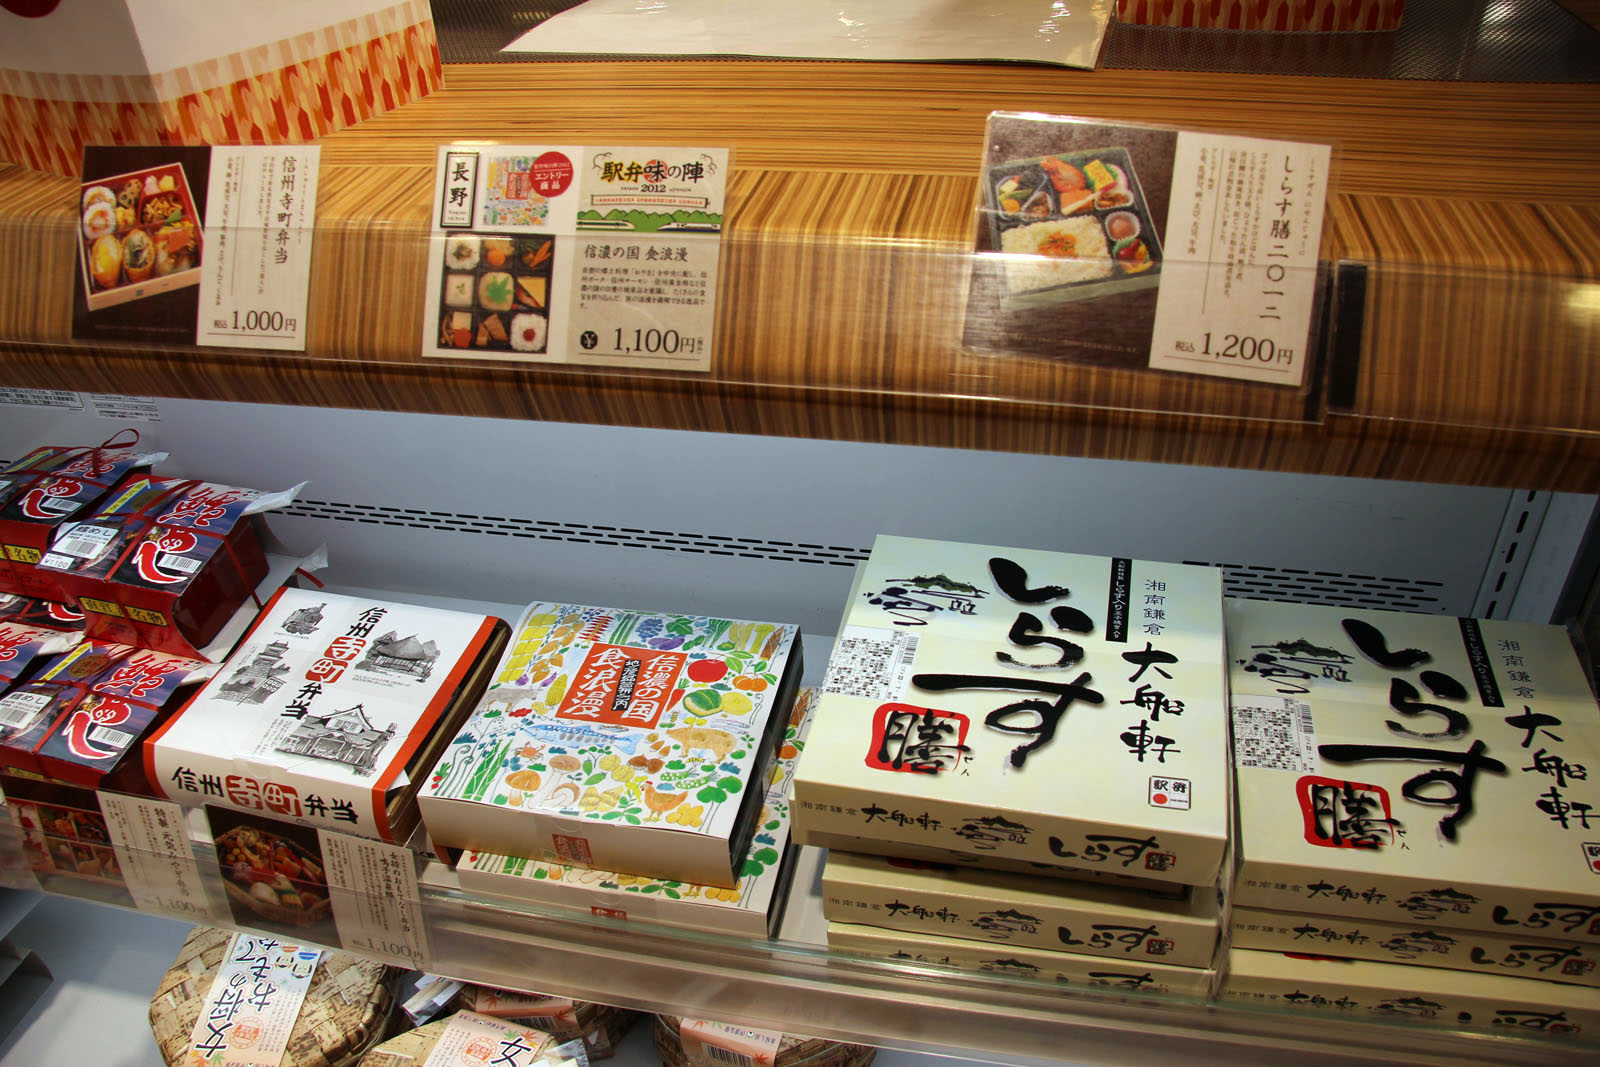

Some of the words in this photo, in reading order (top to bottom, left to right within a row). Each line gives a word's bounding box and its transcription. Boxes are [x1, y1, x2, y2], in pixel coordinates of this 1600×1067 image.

[448, 161, 470, 208] 長野
[535, 172, 570, 181] エントリー
[540, 181, 561, 191] 商品
[600, 160, 704, 184] 駅弁味の陣
[640, 184, 667, 193] 2012
[274, 155, 298, 265] 信州寺町弁当
[584, 244, 640, 260] 信濃の国
[1259, 154, 1294, 321] しらす膳二〇一二
[231, 310, 297, 333] 1,000円
[612, 326, 696, 357] 1,100円
[1174, 340, 1196, 353] 税込
[1201, 331, 1294, 366] 1,200円
[1143, 579, 1167, 636] 湘南鎌倉
[280, 606, 388, 720] 信州寺町弁当
[911, 557, 1104, 769] しらす
[1497, 639, 1536, 699] 湘南鎌倉
[563, 647, 630, 718] 食浪漫
[621, 654, 680, 723] 信濃の国
[1120, 642, 1186, 764] 大船軒
[1317, 618, 1508, 844] しらす
[1505, 705, 1600, 830] 大船軒
[172, 765, 360, 824] 信州寺町弁当
[861, 803, 943, 832] 大船軒
[1048, 834, 1160, 868] しらす
[1306, 879, 1388, 904] 大船軒
[884, 900, 962, 924] 大船軒
[1057, 923, 1160, 953] しらす
[1292, 923, 1370, 945] 大船軒
[1470, 944, 1583, 972] しらす
